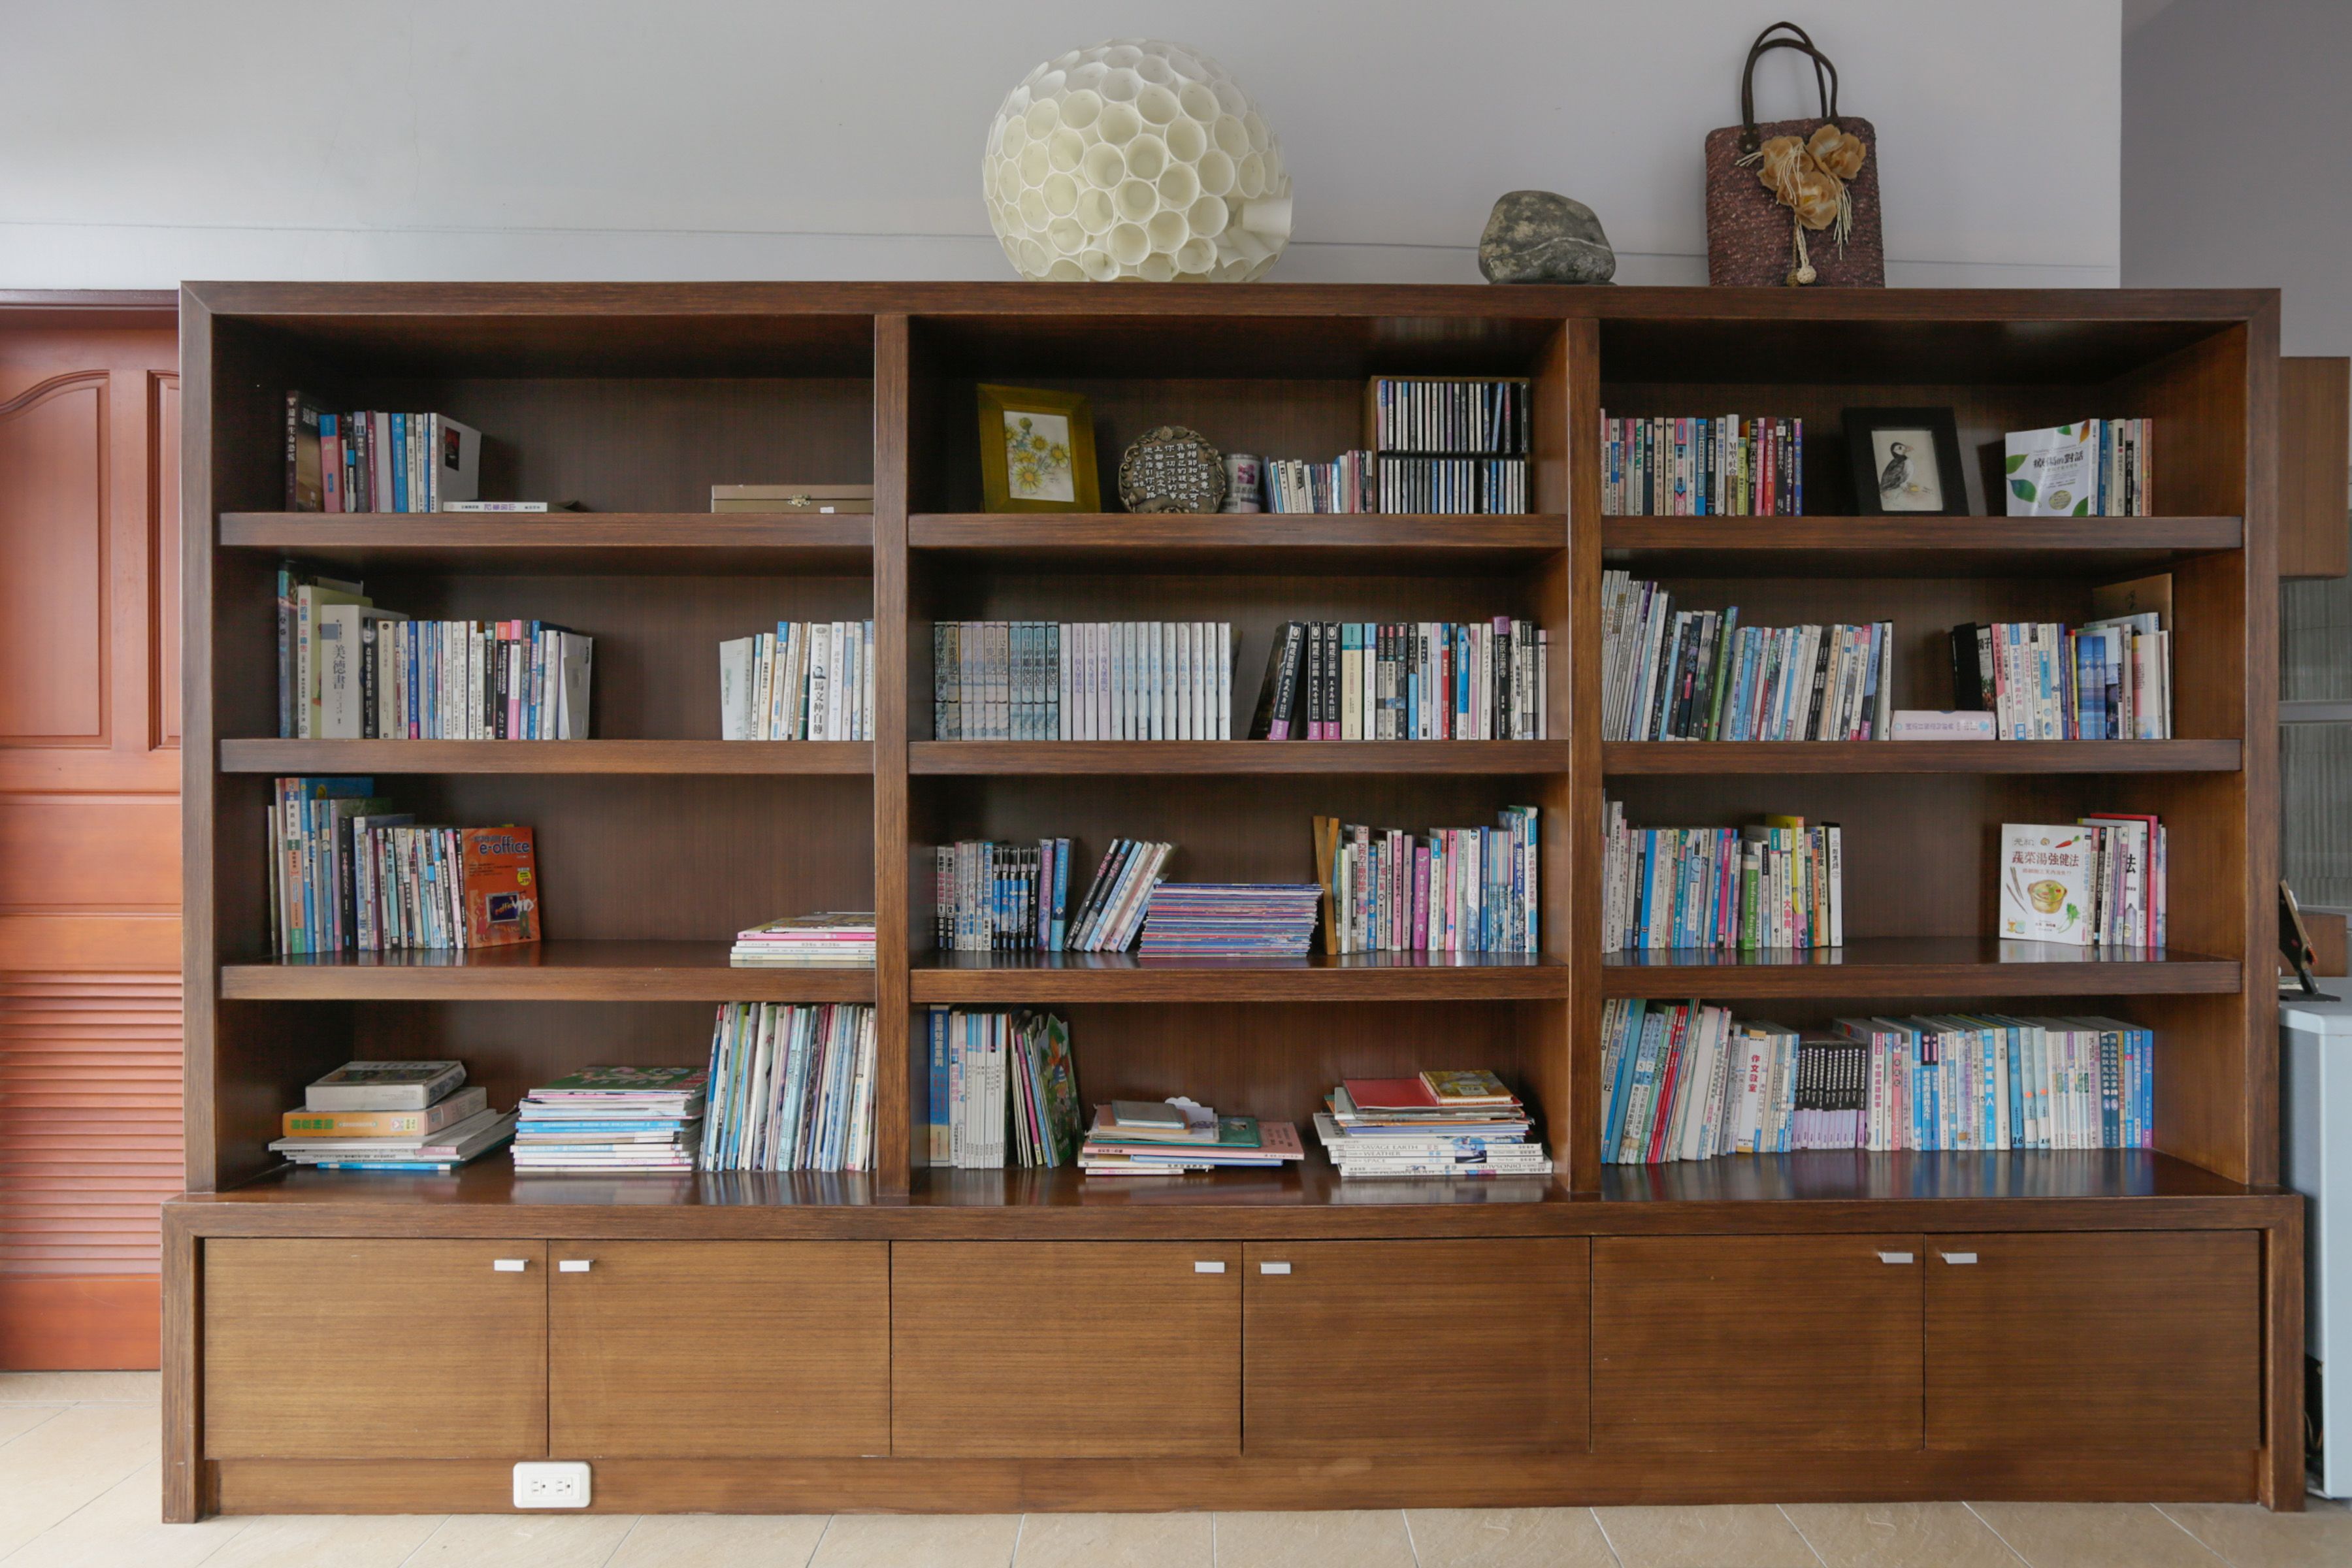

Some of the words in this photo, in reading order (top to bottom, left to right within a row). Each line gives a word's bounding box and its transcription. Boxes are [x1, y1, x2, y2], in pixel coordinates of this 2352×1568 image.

[1729, 442, 1738, 476] M型社會
[333, 644, 346, 690] 美德書
[998, 647, 1007, 676] 鹿鼎記
[480, 836, 530, 855] e-office
[2012, 851, 2080, 867] 蔬菜湯強健法
[1030, 896, 1036, 905] 5
[1748, 1054, 1761, 1093] 作文教室
